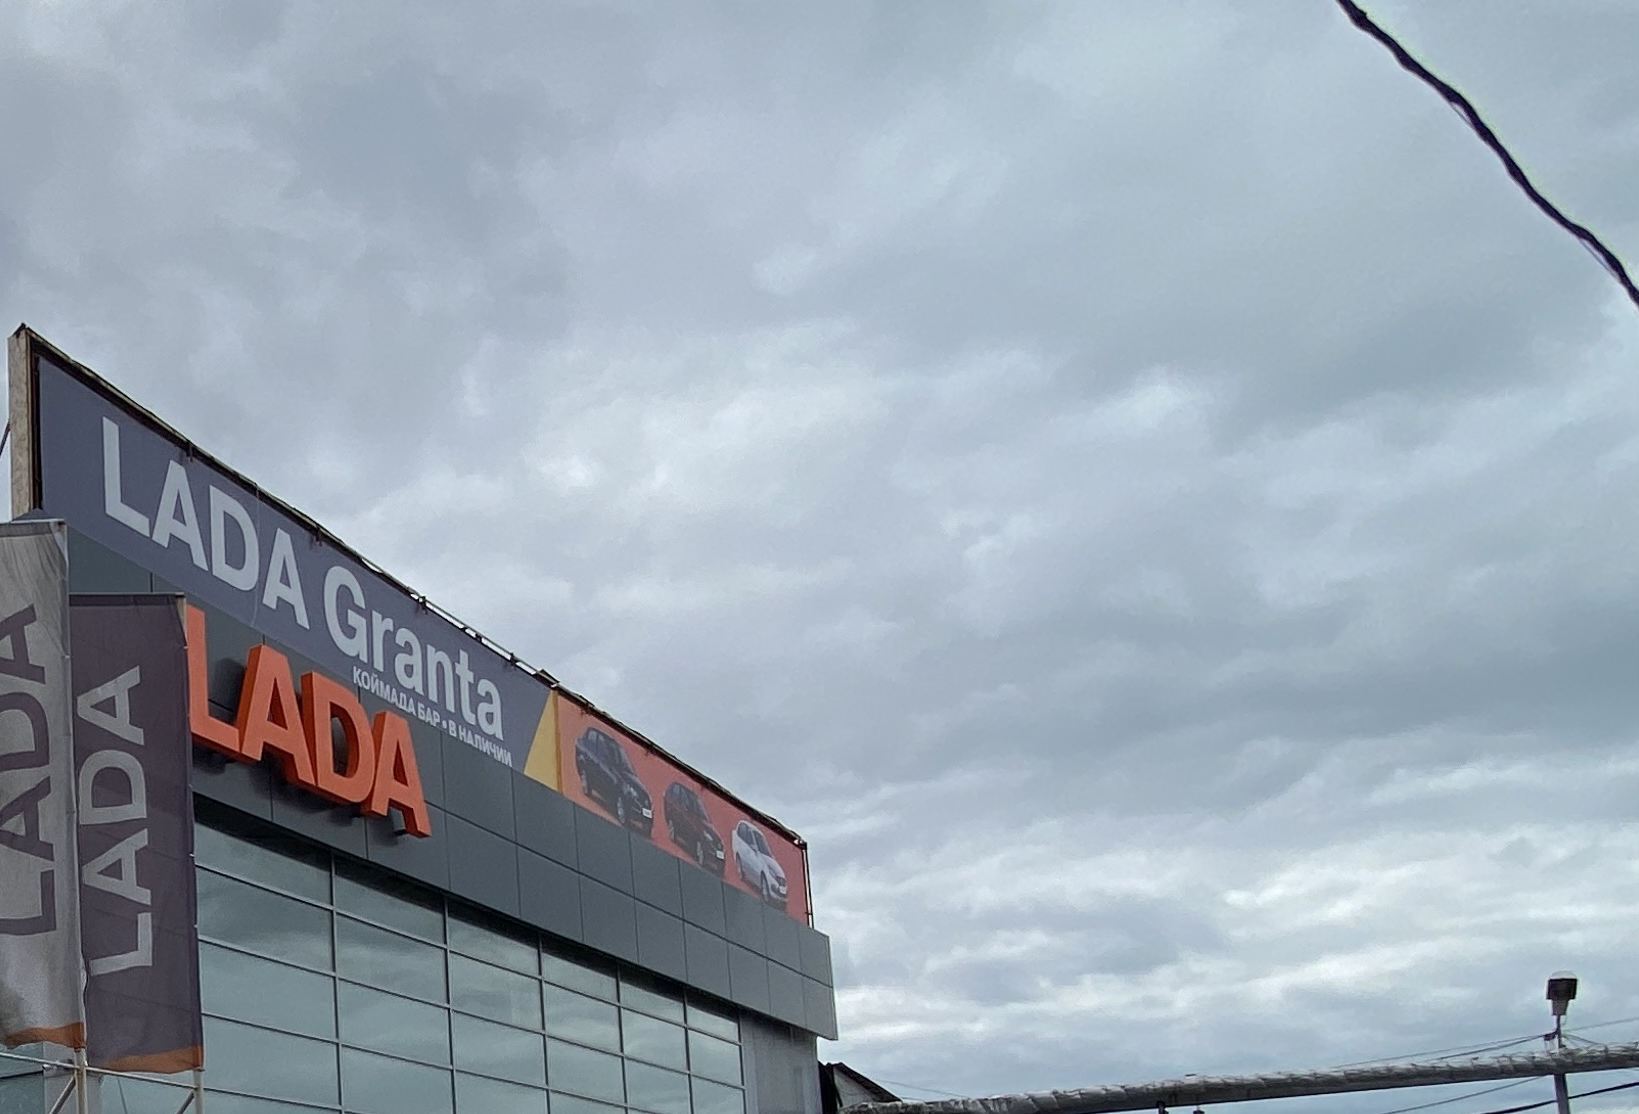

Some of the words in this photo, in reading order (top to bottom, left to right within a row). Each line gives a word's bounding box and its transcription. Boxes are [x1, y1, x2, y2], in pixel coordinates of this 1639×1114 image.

[102, 416, 310, 630] LADA
[323, 565, 504, 742] Granta
[77, 665, 154, 978] LADA
[187, 604, 431, 839] LADA
[353, 666, 416, 716] КОЙМАДА
[417, 703, 441, 726] БАР
[448, 720, 457, 738] В
[458, 724, 513, 768] НАЛИЧИИ
